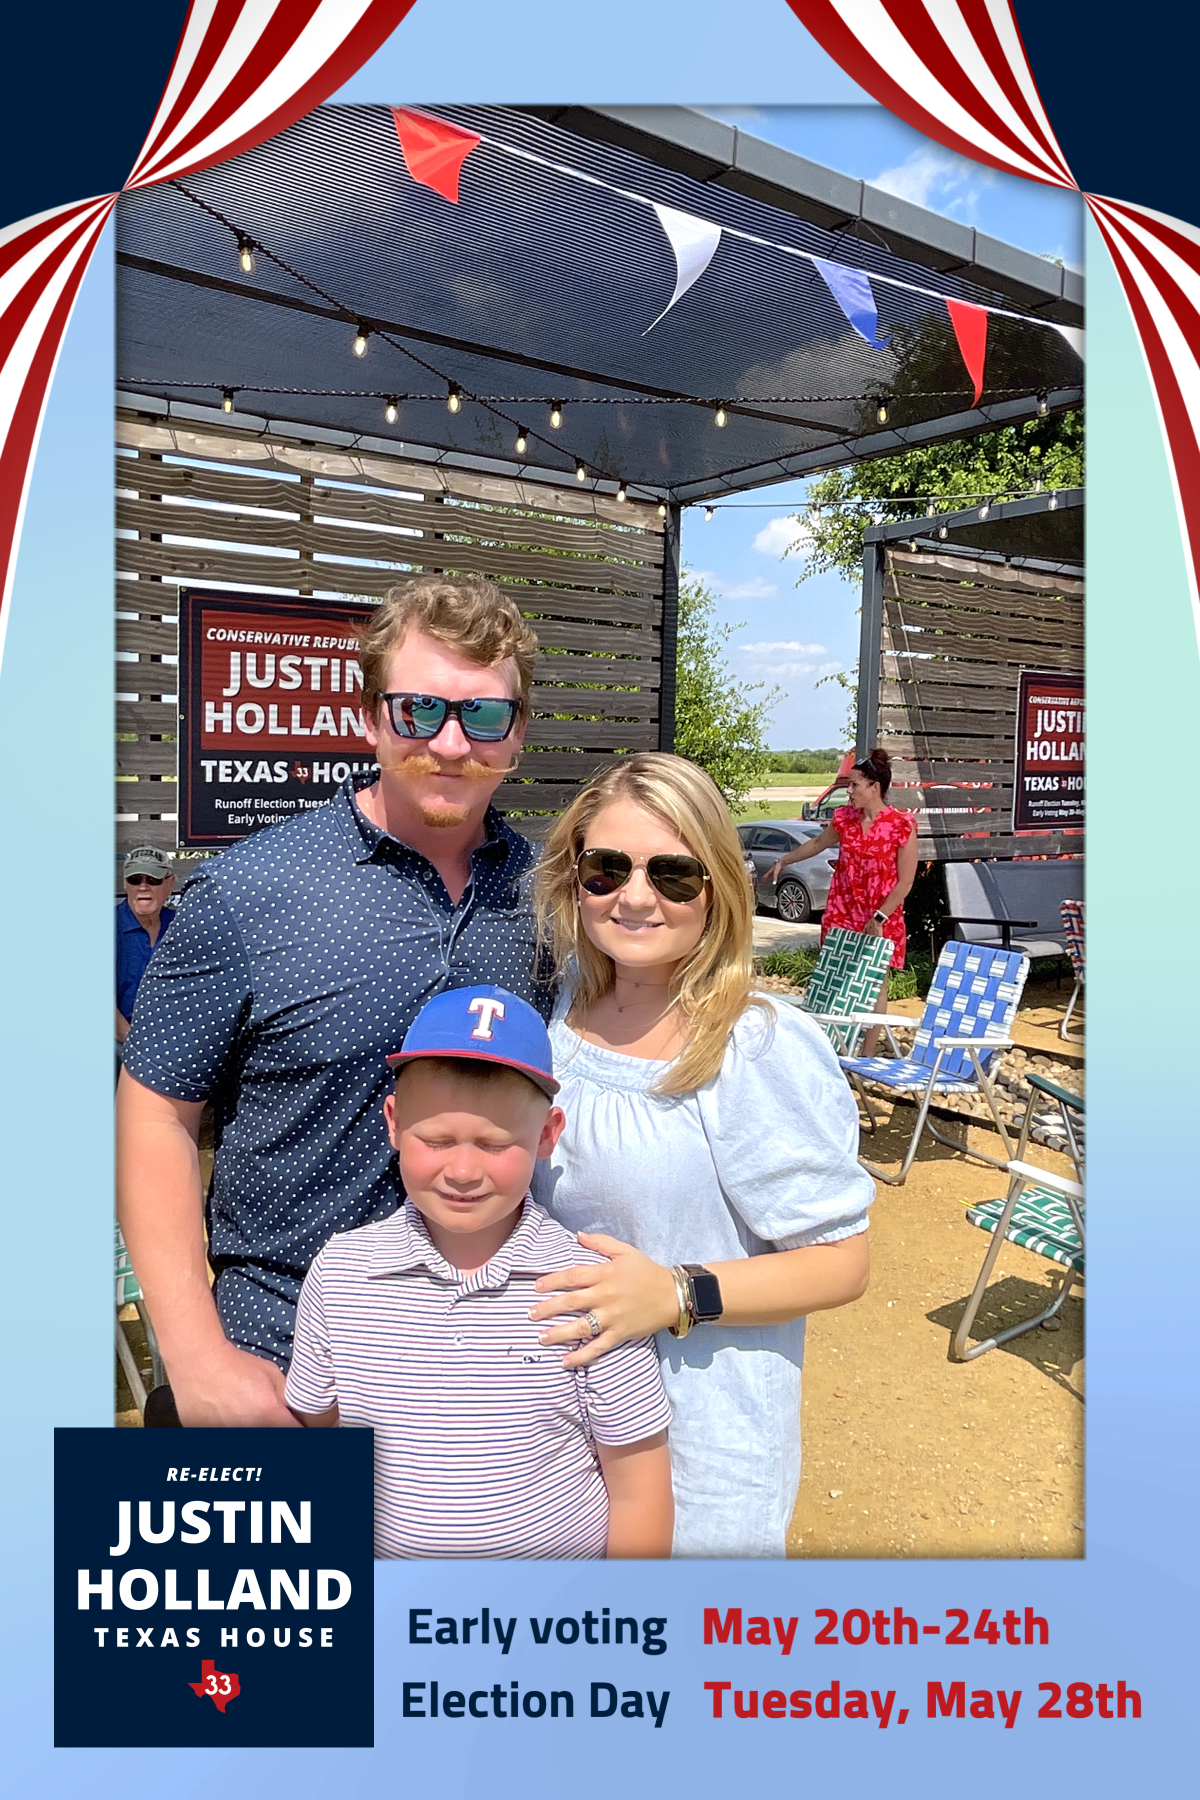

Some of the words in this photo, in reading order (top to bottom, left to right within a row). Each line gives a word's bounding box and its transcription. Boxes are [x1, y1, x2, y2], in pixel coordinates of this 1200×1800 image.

[206, 628, 311, 647] CONSERVATIVE
[201, 760, 289, 783] TEXAS
[296, 767, 309, 778] 33
[1024, 776, 1060, 791] TEXAS
[215, 798, 252, 809] Runoff
[254, 798, 296, 809] Election
[228, 813, 255, 826] Early
[467, 997, 506, 1042] T
